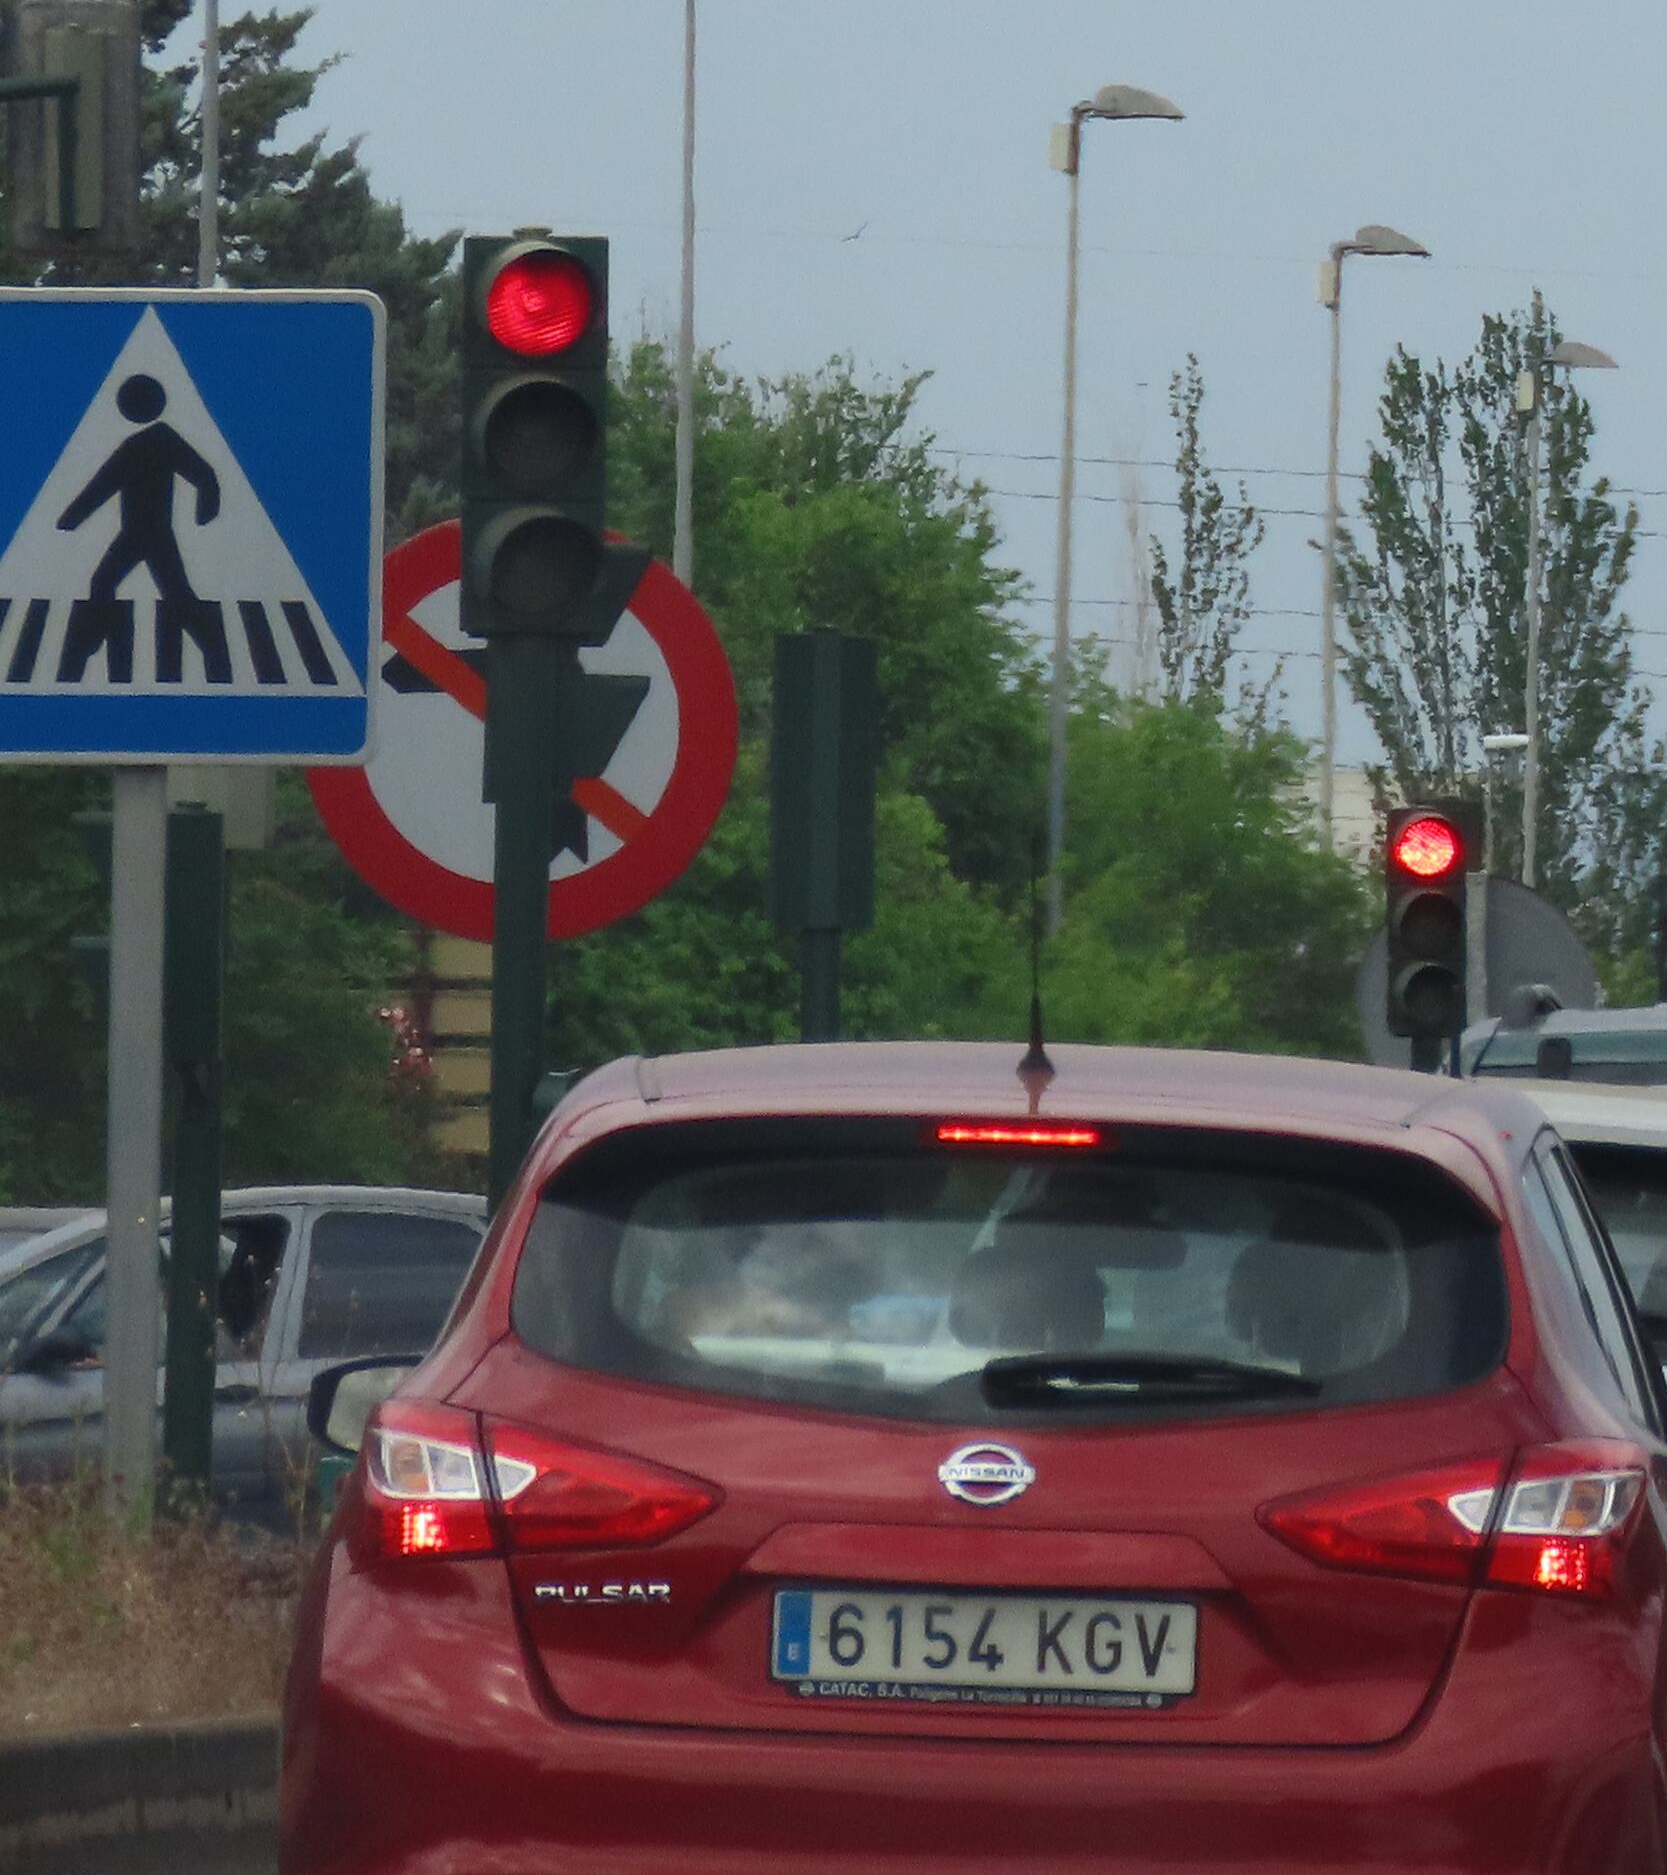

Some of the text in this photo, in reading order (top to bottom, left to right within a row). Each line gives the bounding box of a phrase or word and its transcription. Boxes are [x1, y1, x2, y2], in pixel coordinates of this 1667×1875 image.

[948, 1466, 1025, 1478] NISSAN
[534, 1584, 671, 1603] PULSAR
[828, 1604, 1171, 1677] 6154 KGV
